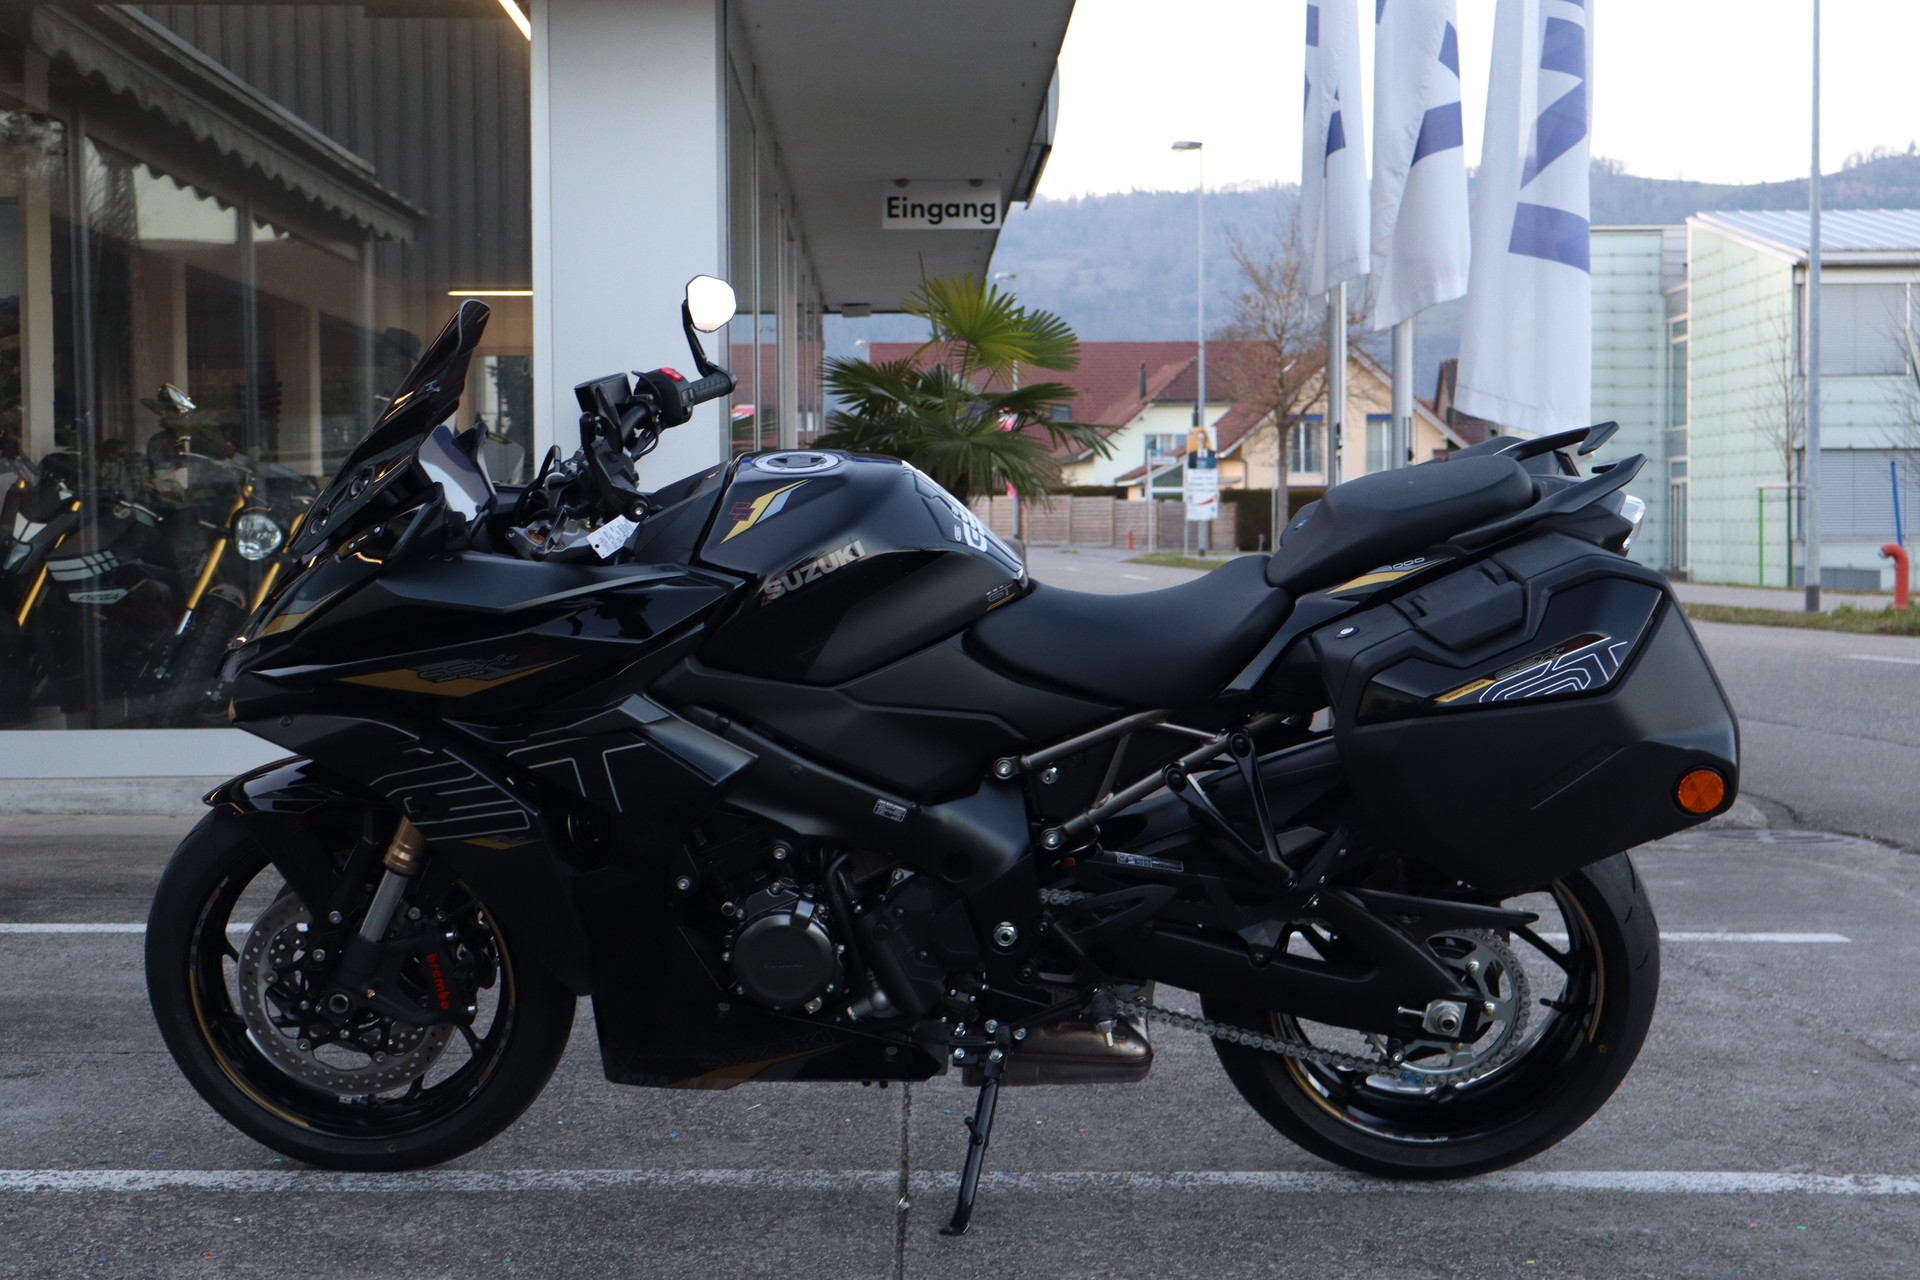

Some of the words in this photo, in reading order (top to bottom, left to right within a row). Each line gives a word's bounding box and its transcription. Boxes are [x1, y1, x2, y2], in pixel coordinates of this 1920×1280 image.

[887, 196, 996, 230] Eingang
[764, 540, 866, 601] SUZUKI
[425, 951, 451, 1010] brembo
